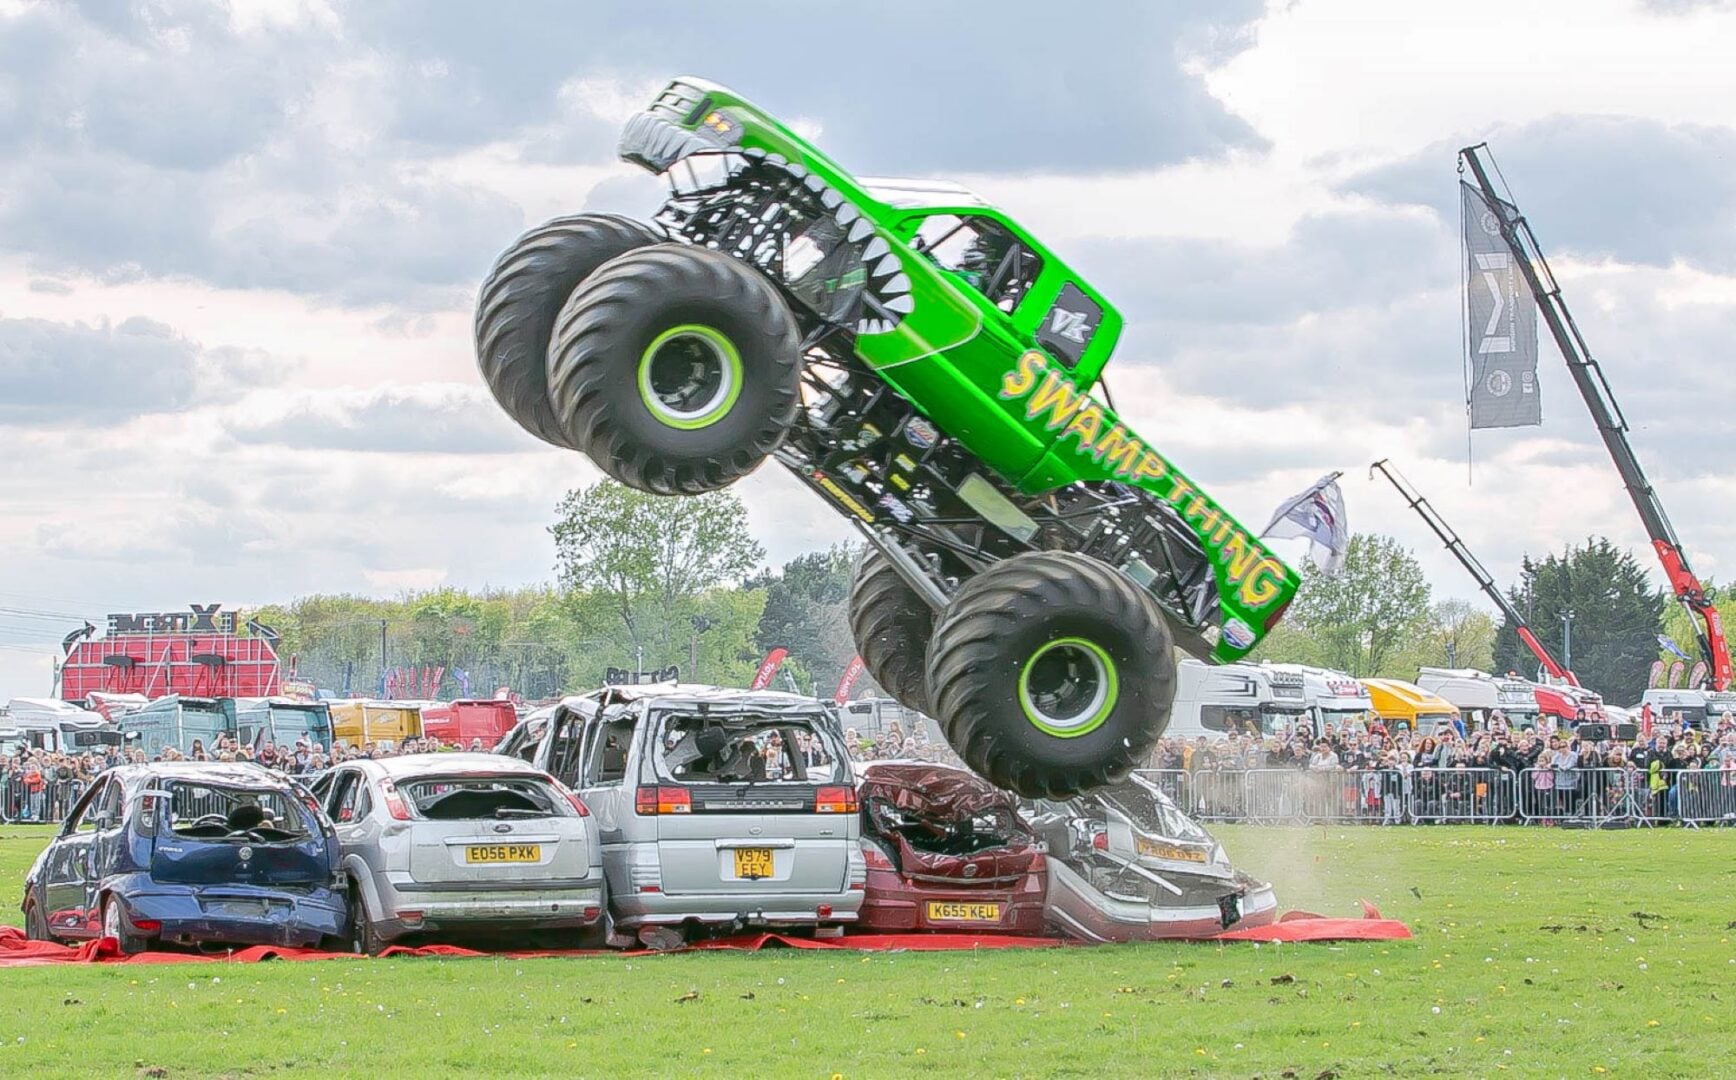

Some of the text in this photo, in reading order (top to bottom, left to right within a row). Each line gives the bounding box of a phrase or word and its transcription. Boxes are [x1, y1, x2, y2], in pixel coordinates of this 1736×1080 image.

[998, 349, 1288, 609] SWAMP THING
[471, 846, 535, 860] EO56 PXK
[738, 850, 771, 862] V979
[741, 863, 767, 877] EEY
[934, 905, 994, 918] K655 KEU
